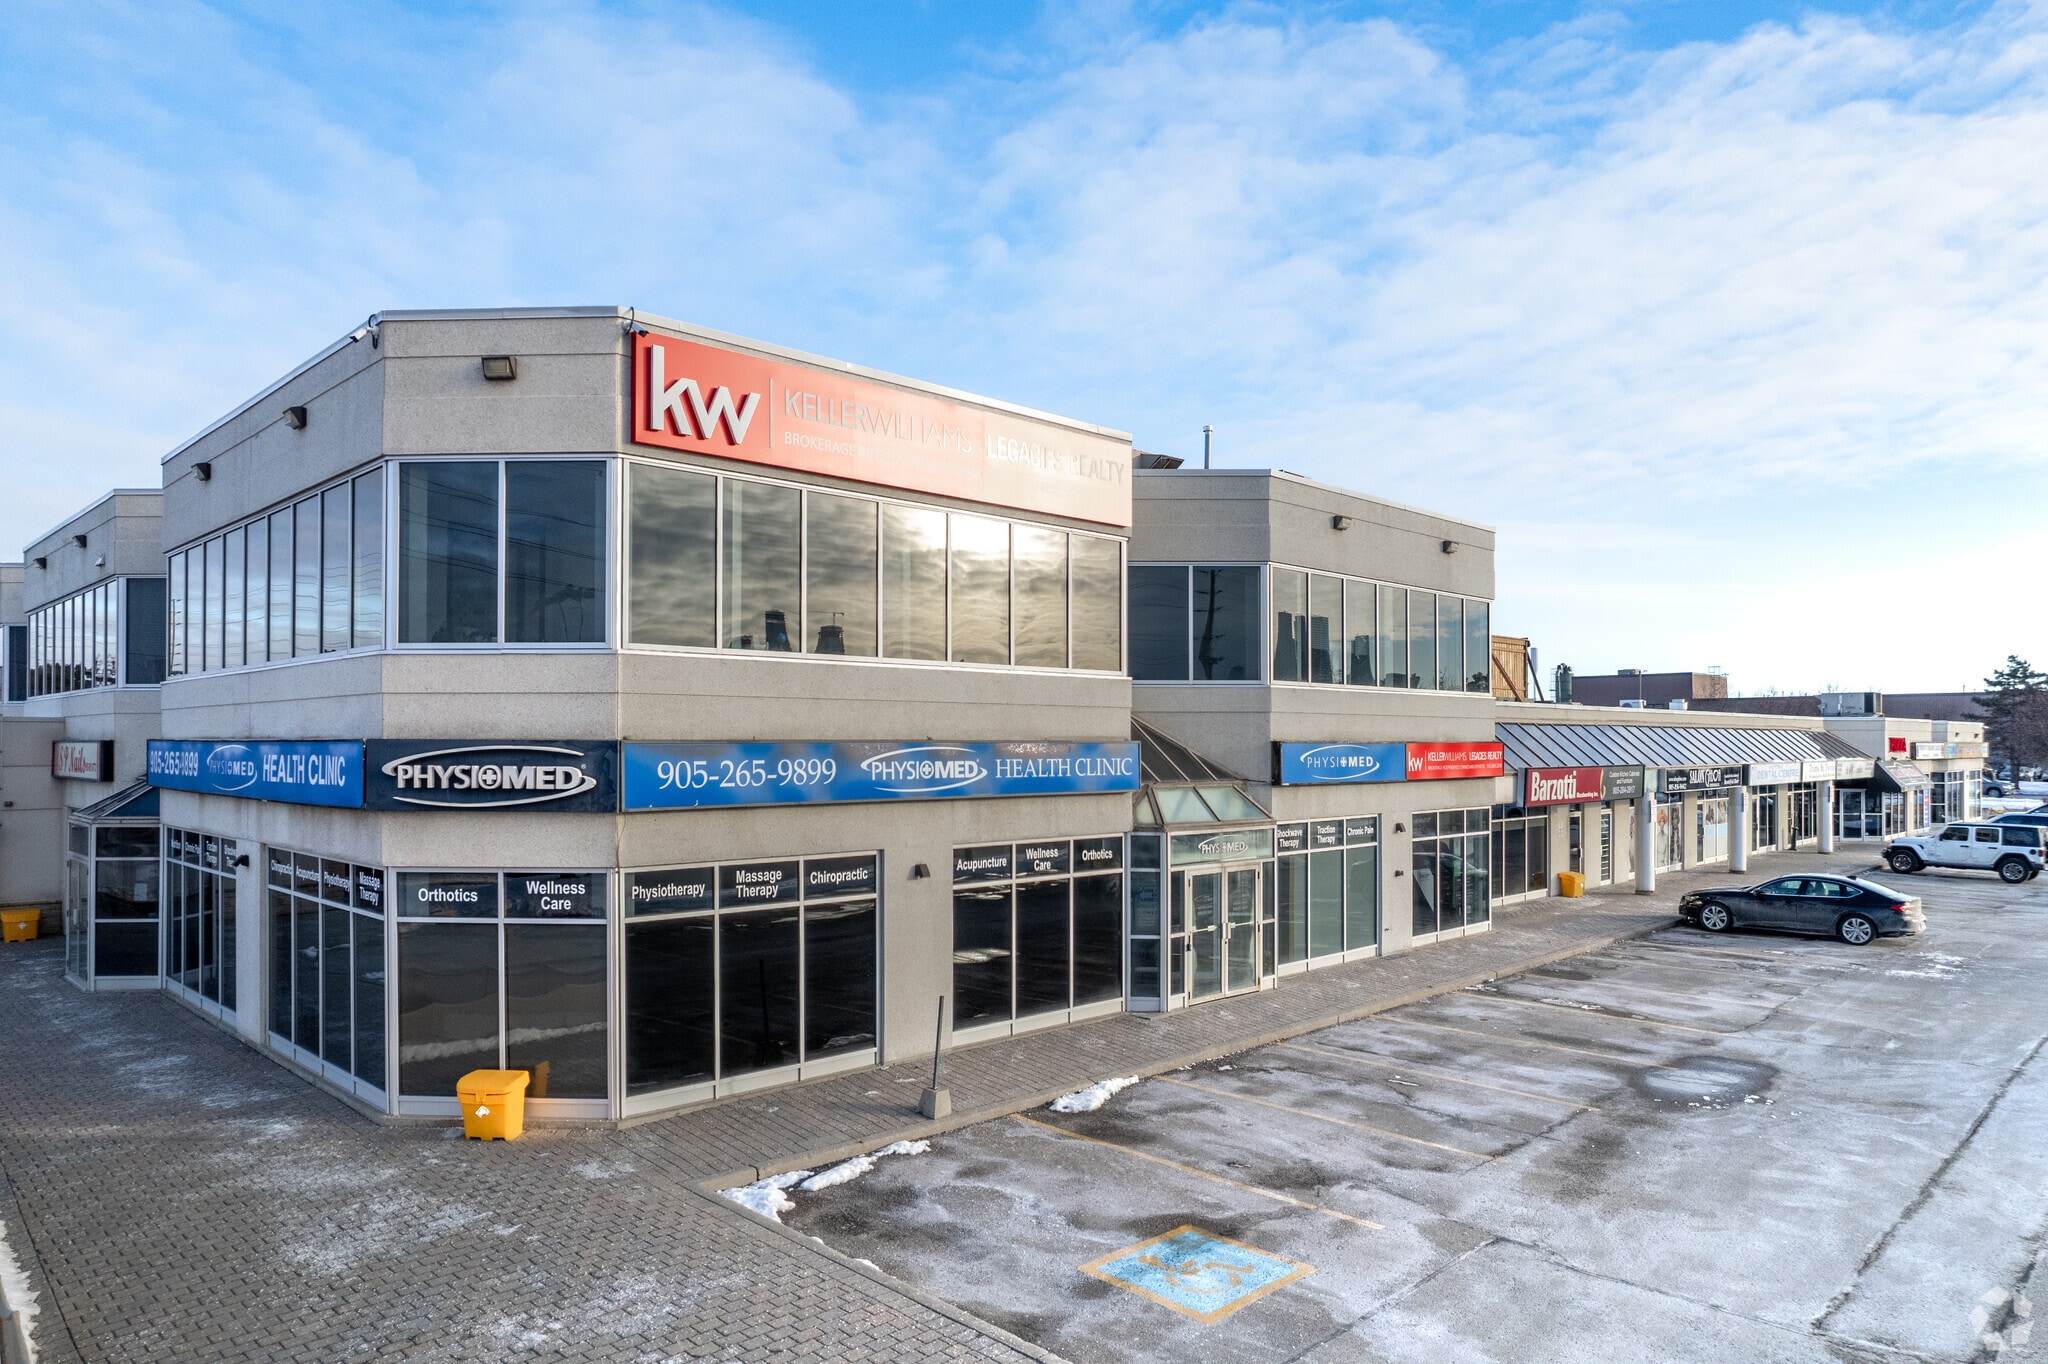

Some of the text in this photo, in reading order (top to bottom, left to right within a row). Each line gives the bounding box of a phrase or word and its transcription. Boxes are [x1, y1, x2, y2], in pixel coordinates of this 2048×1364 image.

[649, 344, 761, 446] kw
[785, 431, 857, 457] BROKERAGE
[987, 434, 1063, 473] LEGACIS
[1069, 451, 1125, 485] REALTY
[1307, 756, 1374, 769] PHYSIOMED
[1408, 751, 1423, 772] kw
[208, 759, 255, 777] PHYSIOMED
[262, 754, 305, 784] HEALTH
[308, 755, 346, 787] CLINIC
[397, 764, 583, 790] PHYSIOMED
[657, 757, 1133, 790] 905-265-9899 PHYSIOMED HEALTH CLINIC
[1689, 769, 1705, 784] SALON
[1757, 769, 1778, 780] DENTAL
[1779, 768, 1799, 779] CENTRE
[1531, 770, 1577, 802] Barzotti
[1317, 825, 1336, 835] Traction
[1347, 825, 1374, 836] Chronic Pain
[1279, 838, 1300, 849] Therapy
[1317, 834, 1336, 845] Therapy
[1025, 847, 1059, 860] Wellness
[1081, 849, 1113, 862] Orthotics
[956, 857, 1007, 872] Acupuncture
[1033, 860, 1052, 871] Care
[359, 872, 380, 891] Massage
[735, 869, 782, 884] Massage
[810, 867, 868, 885] Chiropractic
[526, 880, 586, 895] Wellness
[632, 883, 705, 901] Physiotherapy
[735, 884, 779, 898] Therapy
[359, 886, 379, 906] Therapy
[418, 888, 479, 903] Orthotics
[541, 896, 572, 911] Care
